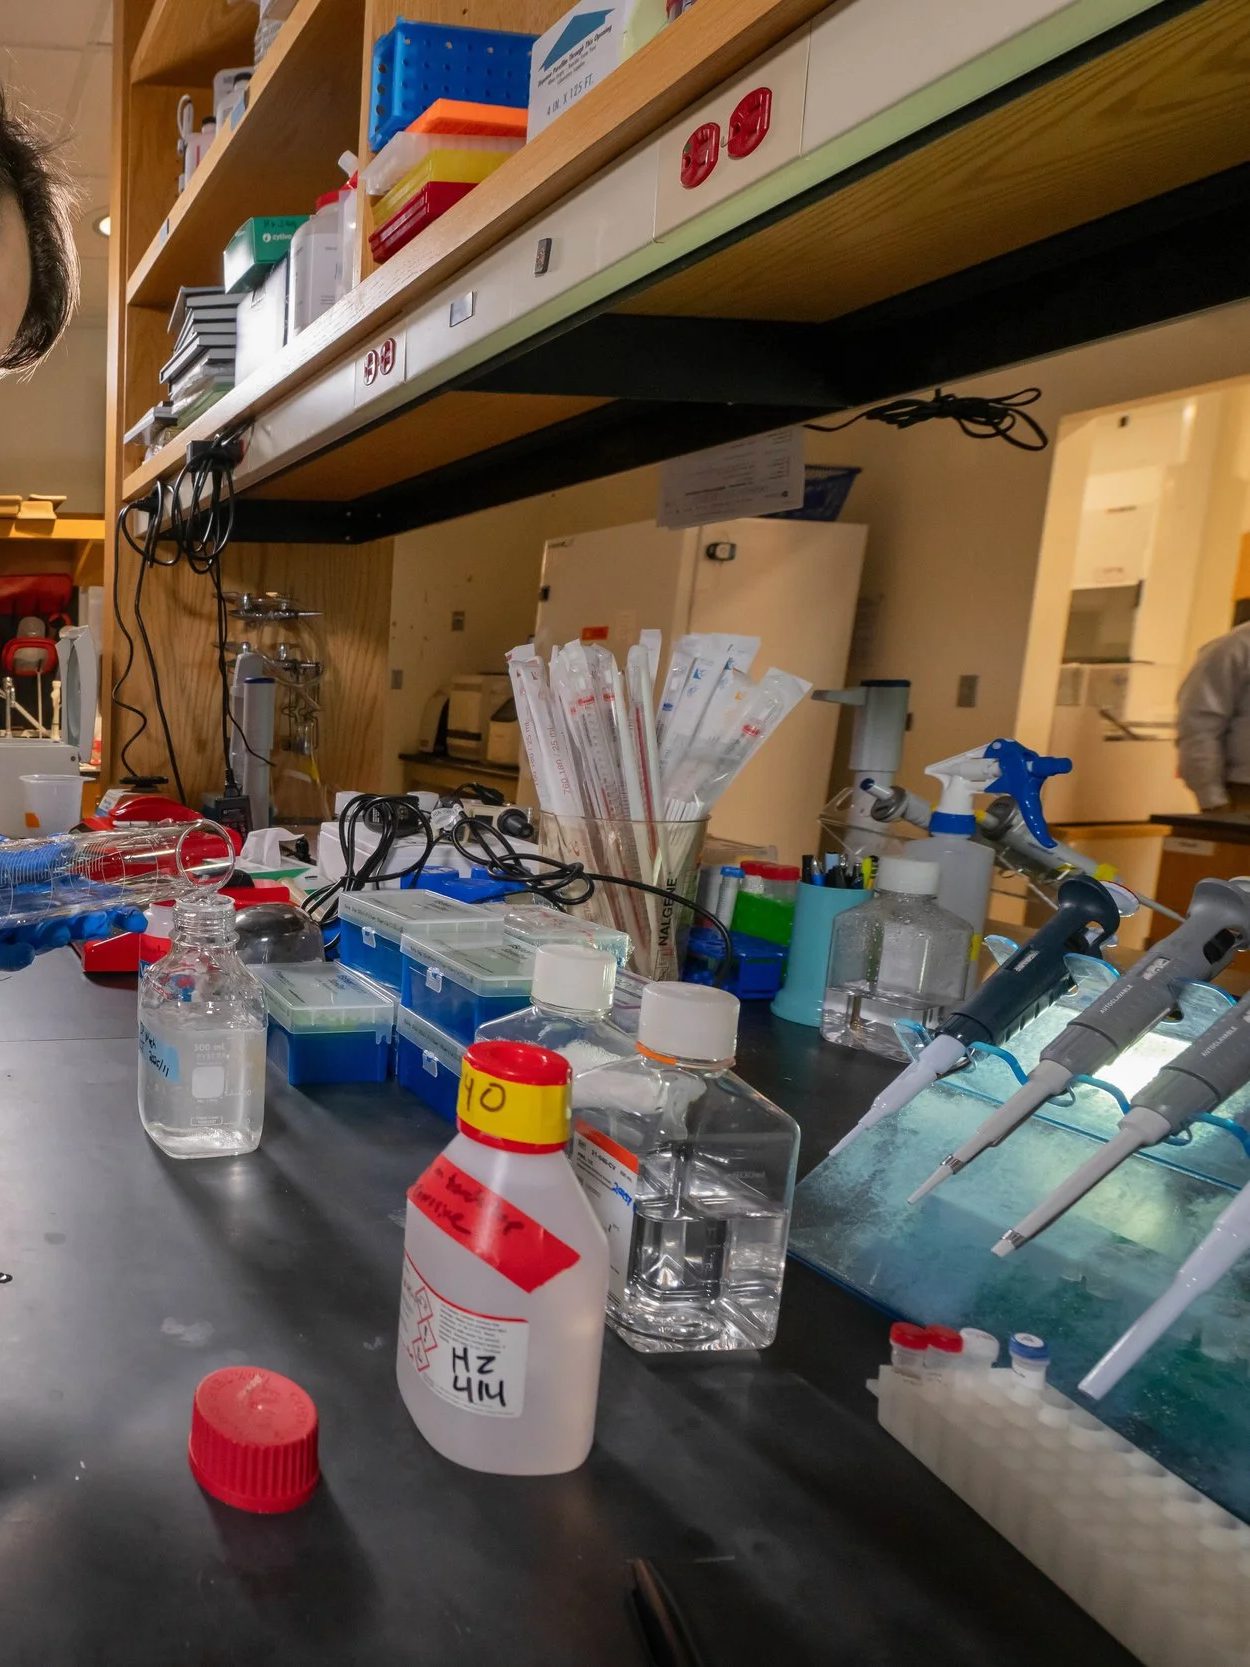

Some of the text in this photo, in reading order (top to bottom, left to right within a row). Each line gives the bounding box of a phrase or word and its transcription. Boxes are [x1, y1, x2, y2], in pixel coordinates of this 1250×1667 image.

[563, 91, 569, 105] X
[570, 82, 583, 99] 125
[551, 740, 560, 752] 25
[1100, 983, 1134, 1014] AUTOCLAVABLE
[1201, 1025, 1238, 1057] AUTOCLAVABLE
[452, 1375, 506, 1407] 414
